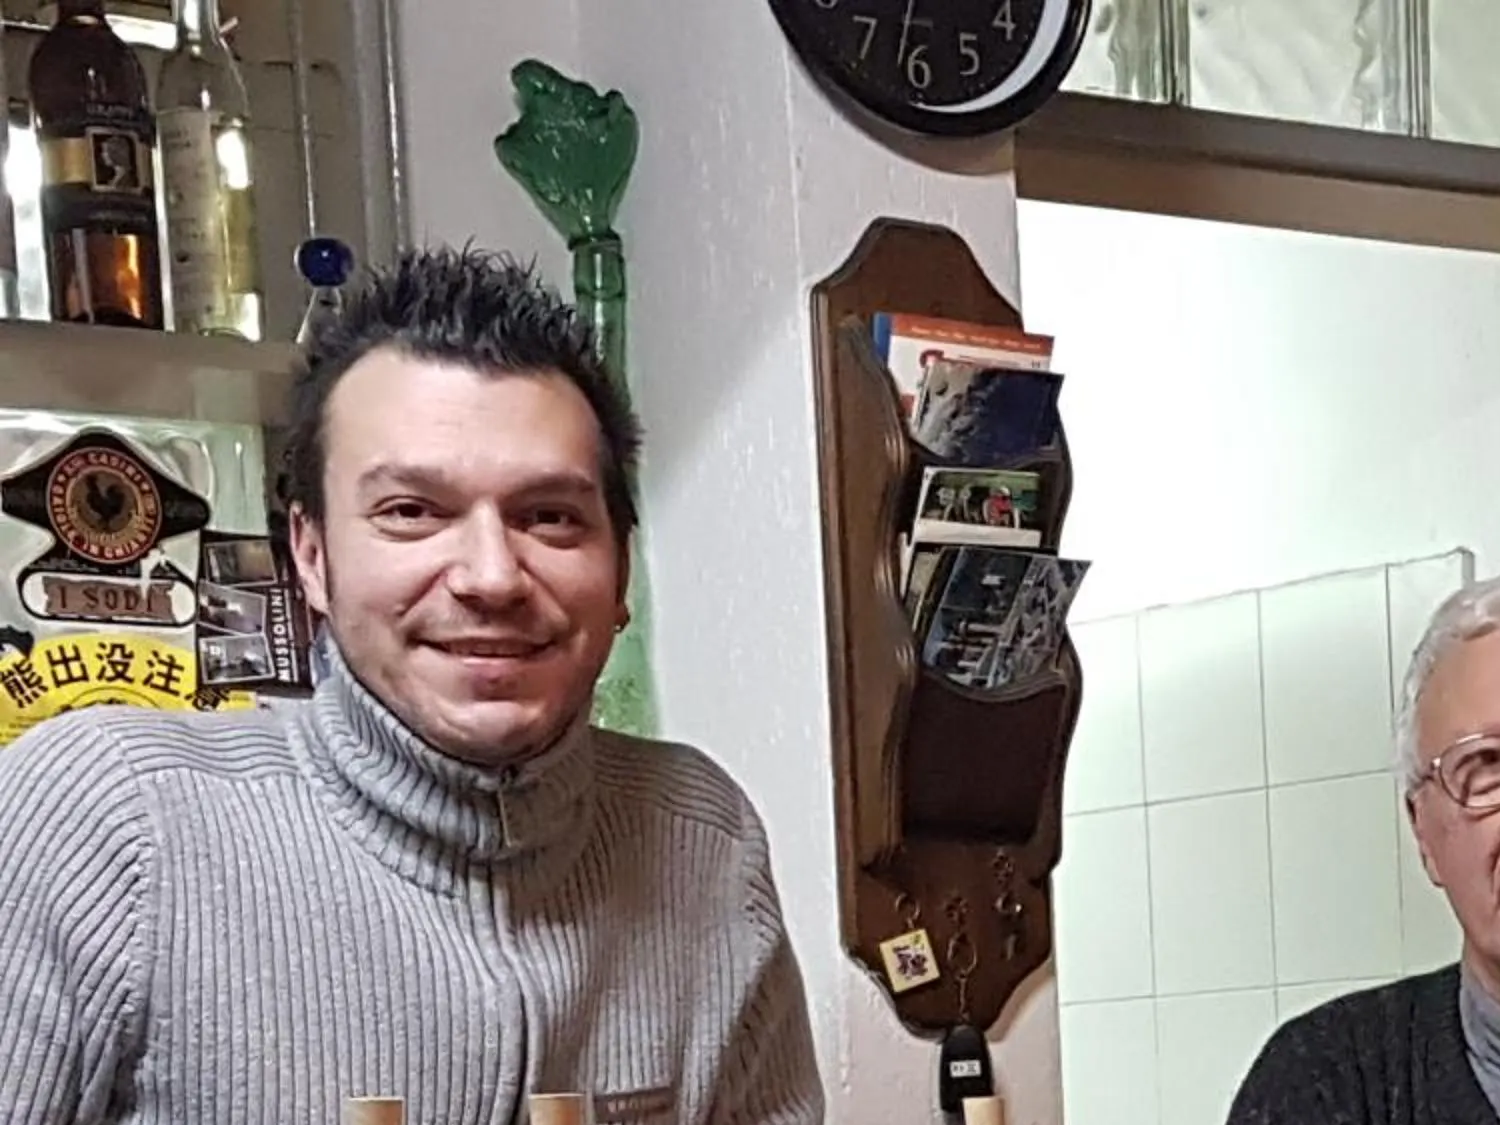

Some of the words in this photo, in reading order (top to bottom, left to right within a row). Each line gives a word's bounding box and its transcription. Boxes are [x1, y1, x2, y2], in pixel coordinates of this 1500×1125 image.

[853, 16, 878, 60] 7
[992, 0, 1016, 40] 4
[907, 45, 931, 89] 6
[959, 32, 980, 75] 5
[82, 586, 154, 613] SODI
[269, 587, 291, 683] MUSSOLINI
